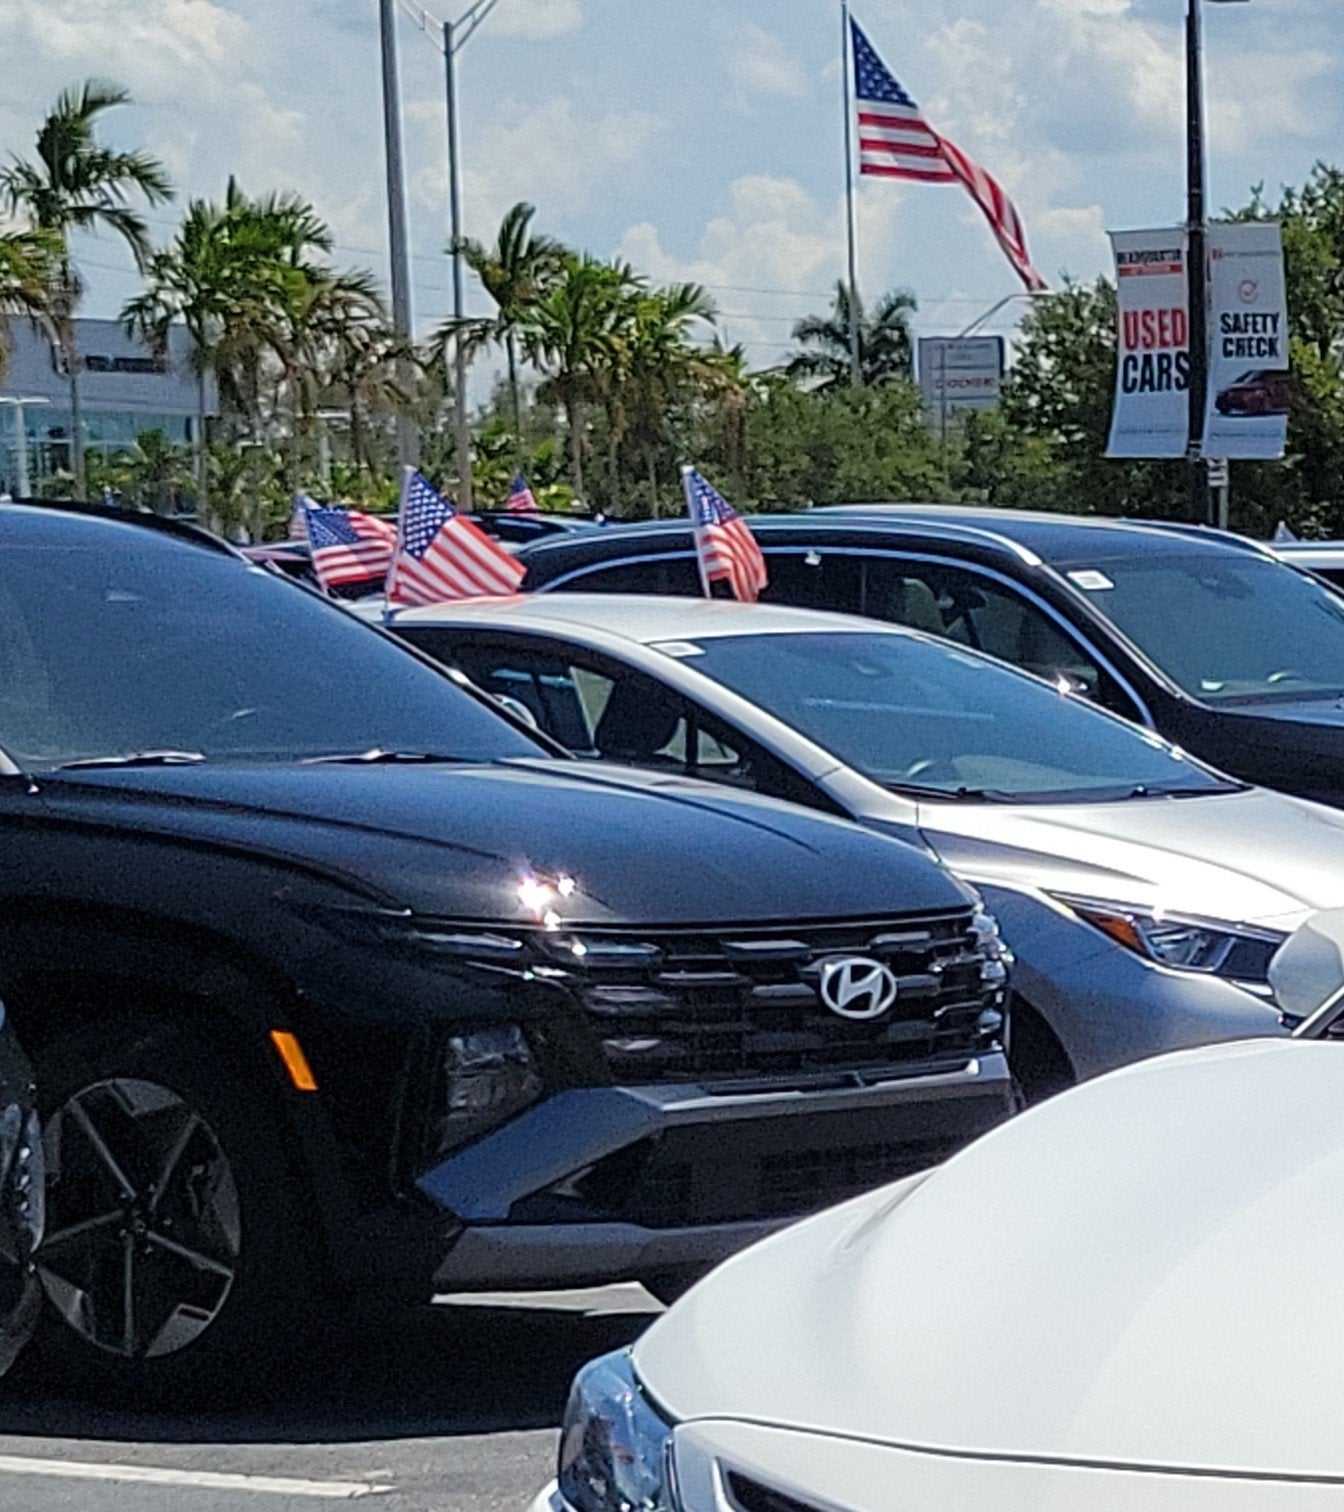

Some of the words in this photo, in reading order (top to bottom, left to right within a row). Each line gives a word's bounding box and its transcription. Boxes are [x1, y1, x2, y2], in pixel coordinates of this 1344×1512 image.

[1123, 308, 1186, 351] USED
[1220, 312, 1280, 334] SAFETY
[1222, 337, 1279, 359] CHECK
[1122, 352, 1189, 394] CARS
